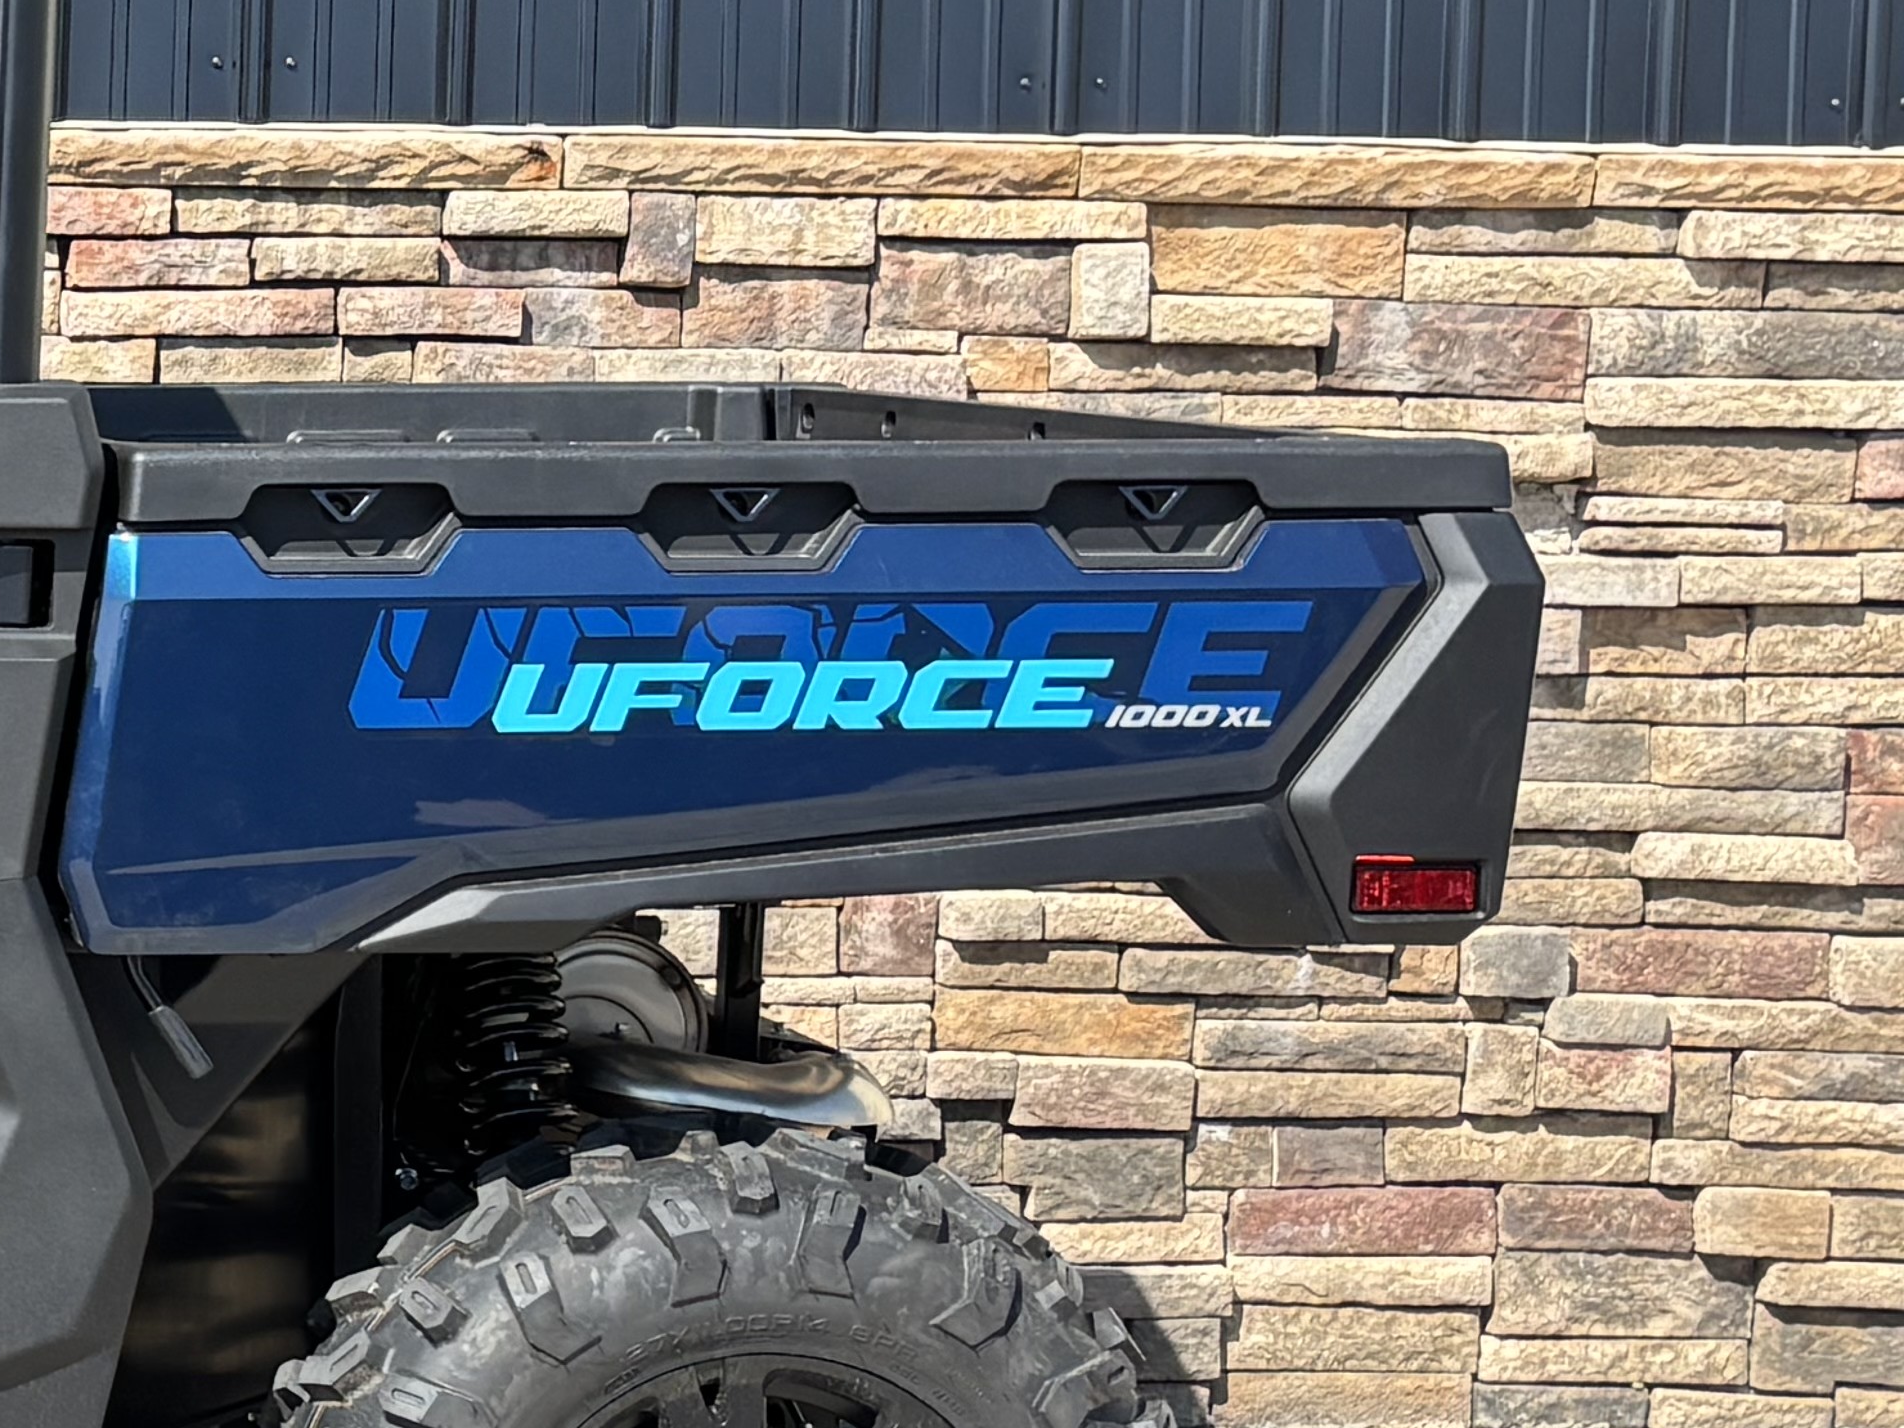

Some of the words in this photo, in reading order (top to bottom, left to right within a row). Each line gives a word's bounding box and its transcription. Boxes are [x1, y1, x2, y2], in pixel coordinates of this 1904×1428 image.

[491, 658, 1114, 733] UFORCE
[1104, 704, 1221, 728] 1000
[1219, 706, 1273, 728] XL
